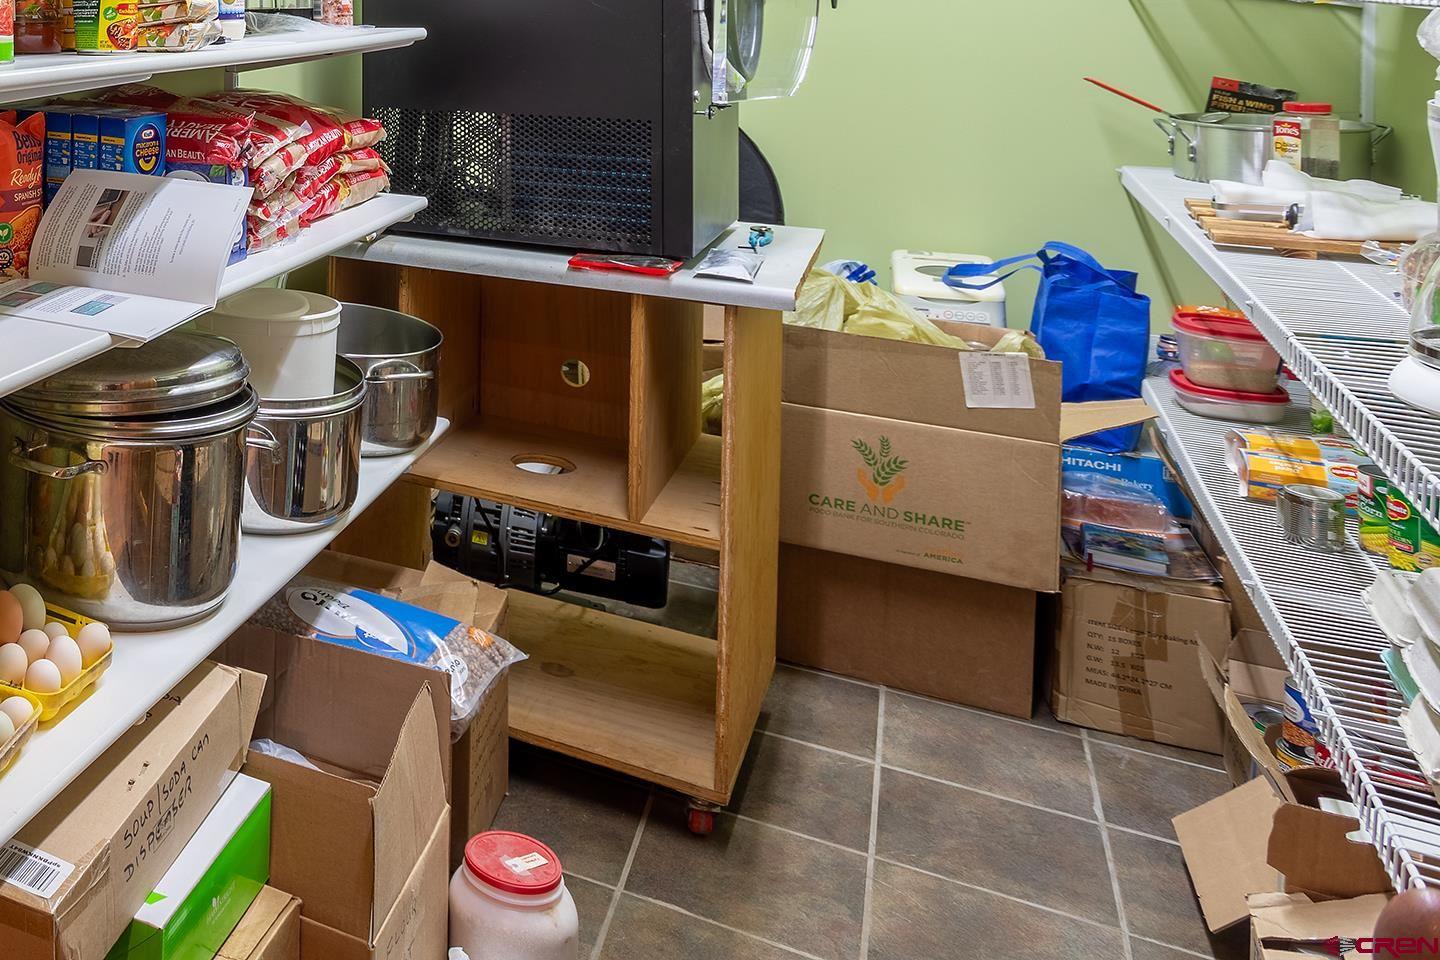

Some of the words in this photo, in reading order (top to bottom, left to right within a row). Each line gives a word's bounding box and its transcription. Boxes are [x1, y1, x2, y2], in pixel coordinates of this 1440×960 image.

[1212, 93, 1238, 104] FISH
[1245, 100, 1276, 112] WING
[166, 126, 220, 144] AMERI
[177, 149, 205, 160] BEAUTY
[10, 168, 38, 189] Ready
[14, 189, 37, 202] SPANISH
[1061, 456, 1122, 472] HITACHI
[808, 493, 856, 512] CARE
[861, 503, 900, 520] AND
[903, 510, 965, 532] SHARE
[1360, 501, 1384, 519] Corn
[832, 511, 856, 521] BANK
[856, 515, 873, 524] FOR
[874, 518, 917, 532] SOUTHERN
[918, 526, 965, 541] COLORADO
[923, 552, 964, 565] AMERICA
[1087, 631, 1104, 640] QTY:
[1085, 678, 1108, 689] MADE
[1117, 685, 1142, 696] CHINA
[191, 733, 210, 762] CAN
